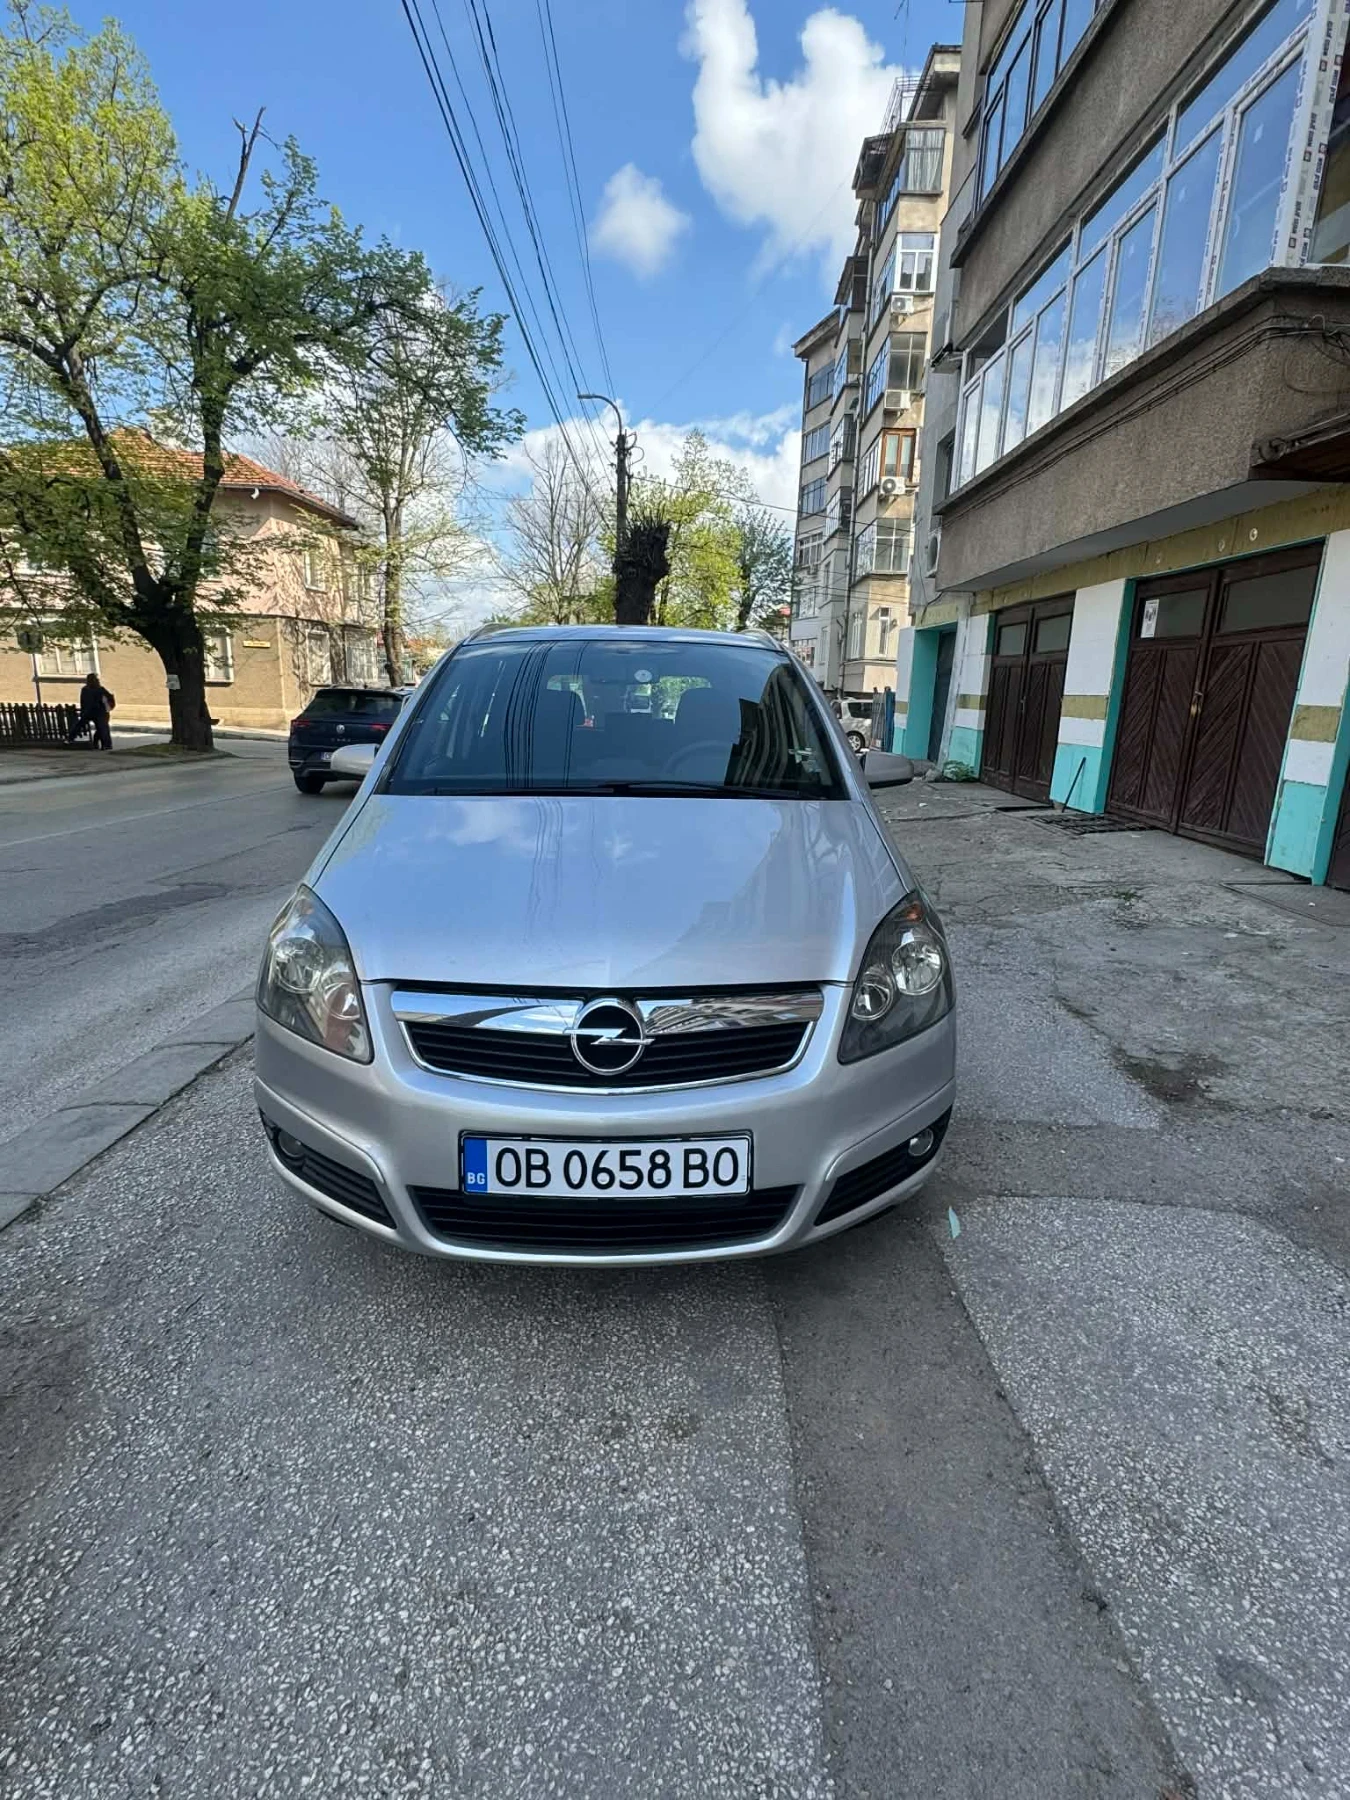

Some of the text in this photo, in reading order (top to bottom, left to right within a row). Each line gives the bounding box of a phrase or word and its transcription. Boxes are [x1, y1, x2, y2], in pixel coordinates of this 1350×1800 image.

[467, 1171, 485, 1184] BG
[495, 1146, 739, 1190] OB 0658 BO
